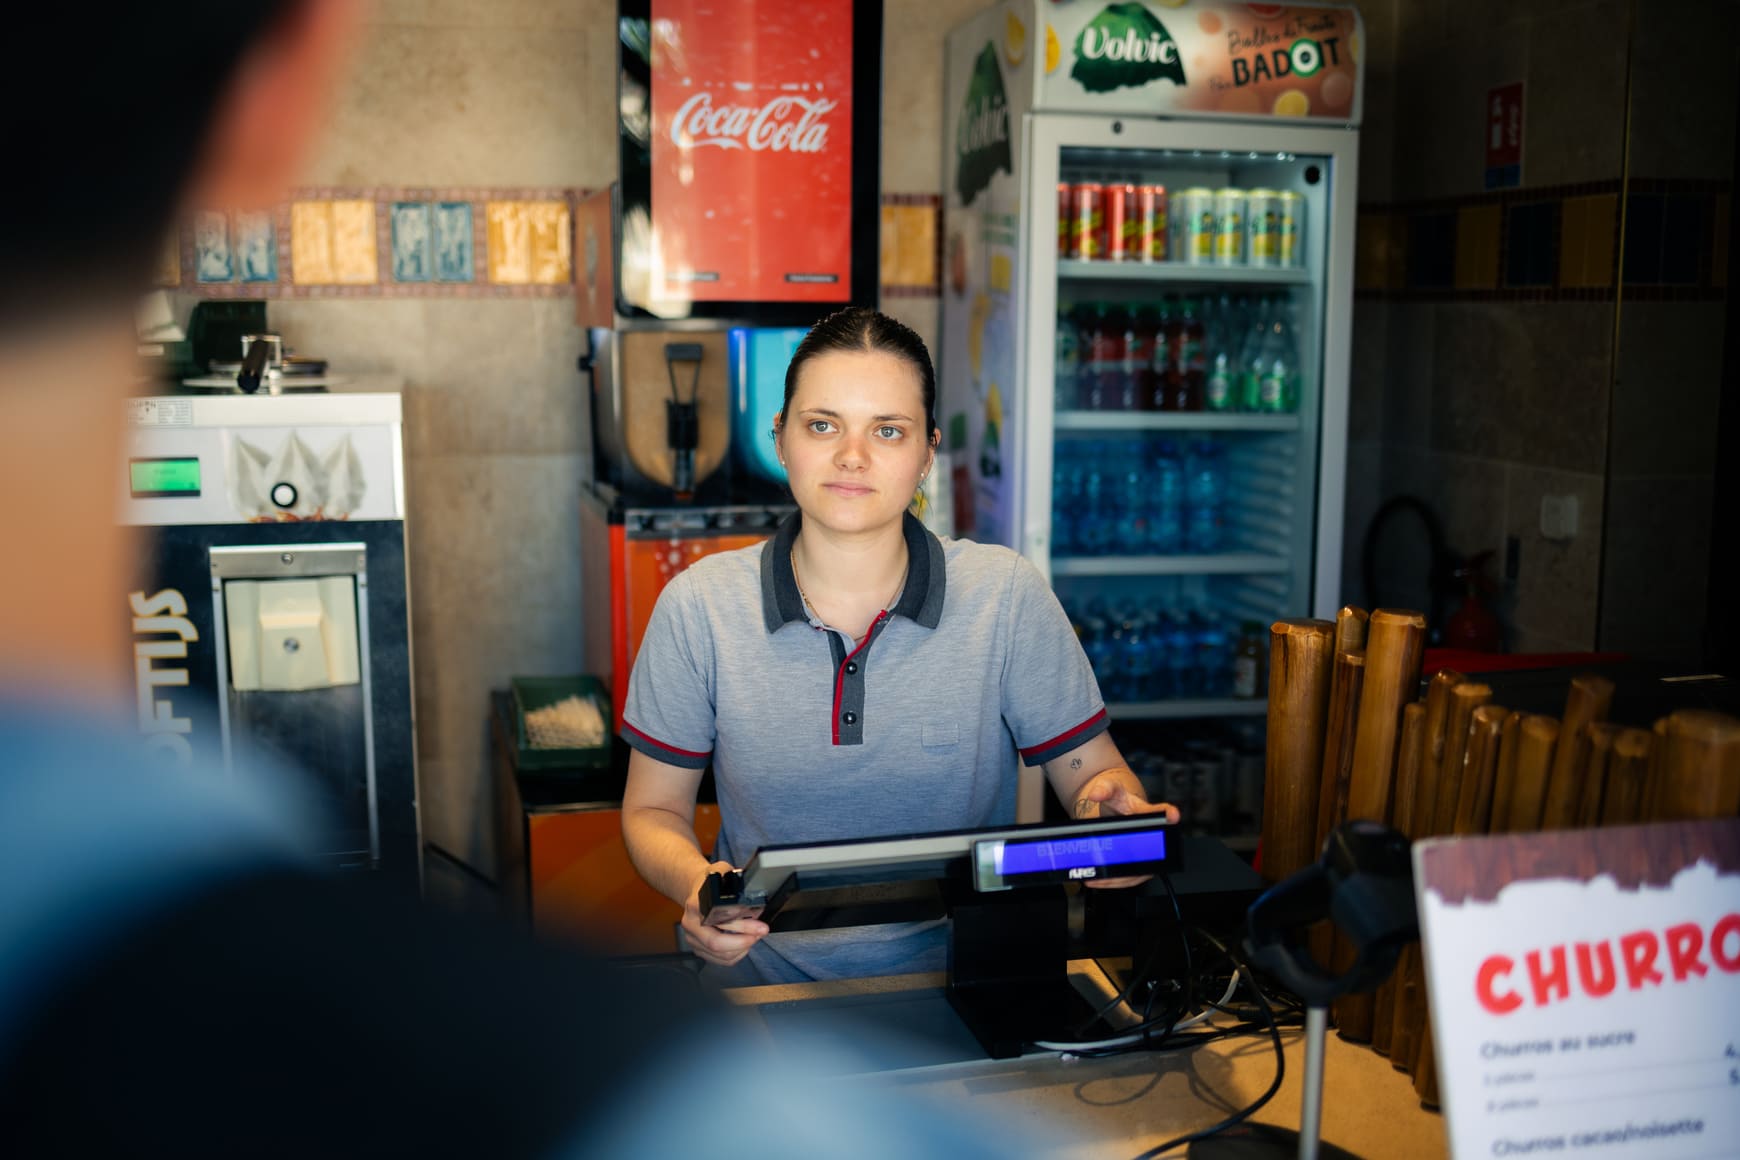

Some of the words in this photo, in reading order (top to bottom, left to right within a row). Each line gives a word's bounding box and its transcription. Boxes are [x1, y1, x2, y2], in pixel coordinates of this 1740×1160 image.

[1081, 26, 1178, 65] Volvic
[1231, 37, 1339, 87] BADOIT
[671, 92, 838, 152] Coca-Cola
[1475, 913, 1740, 1016] CHURRO
